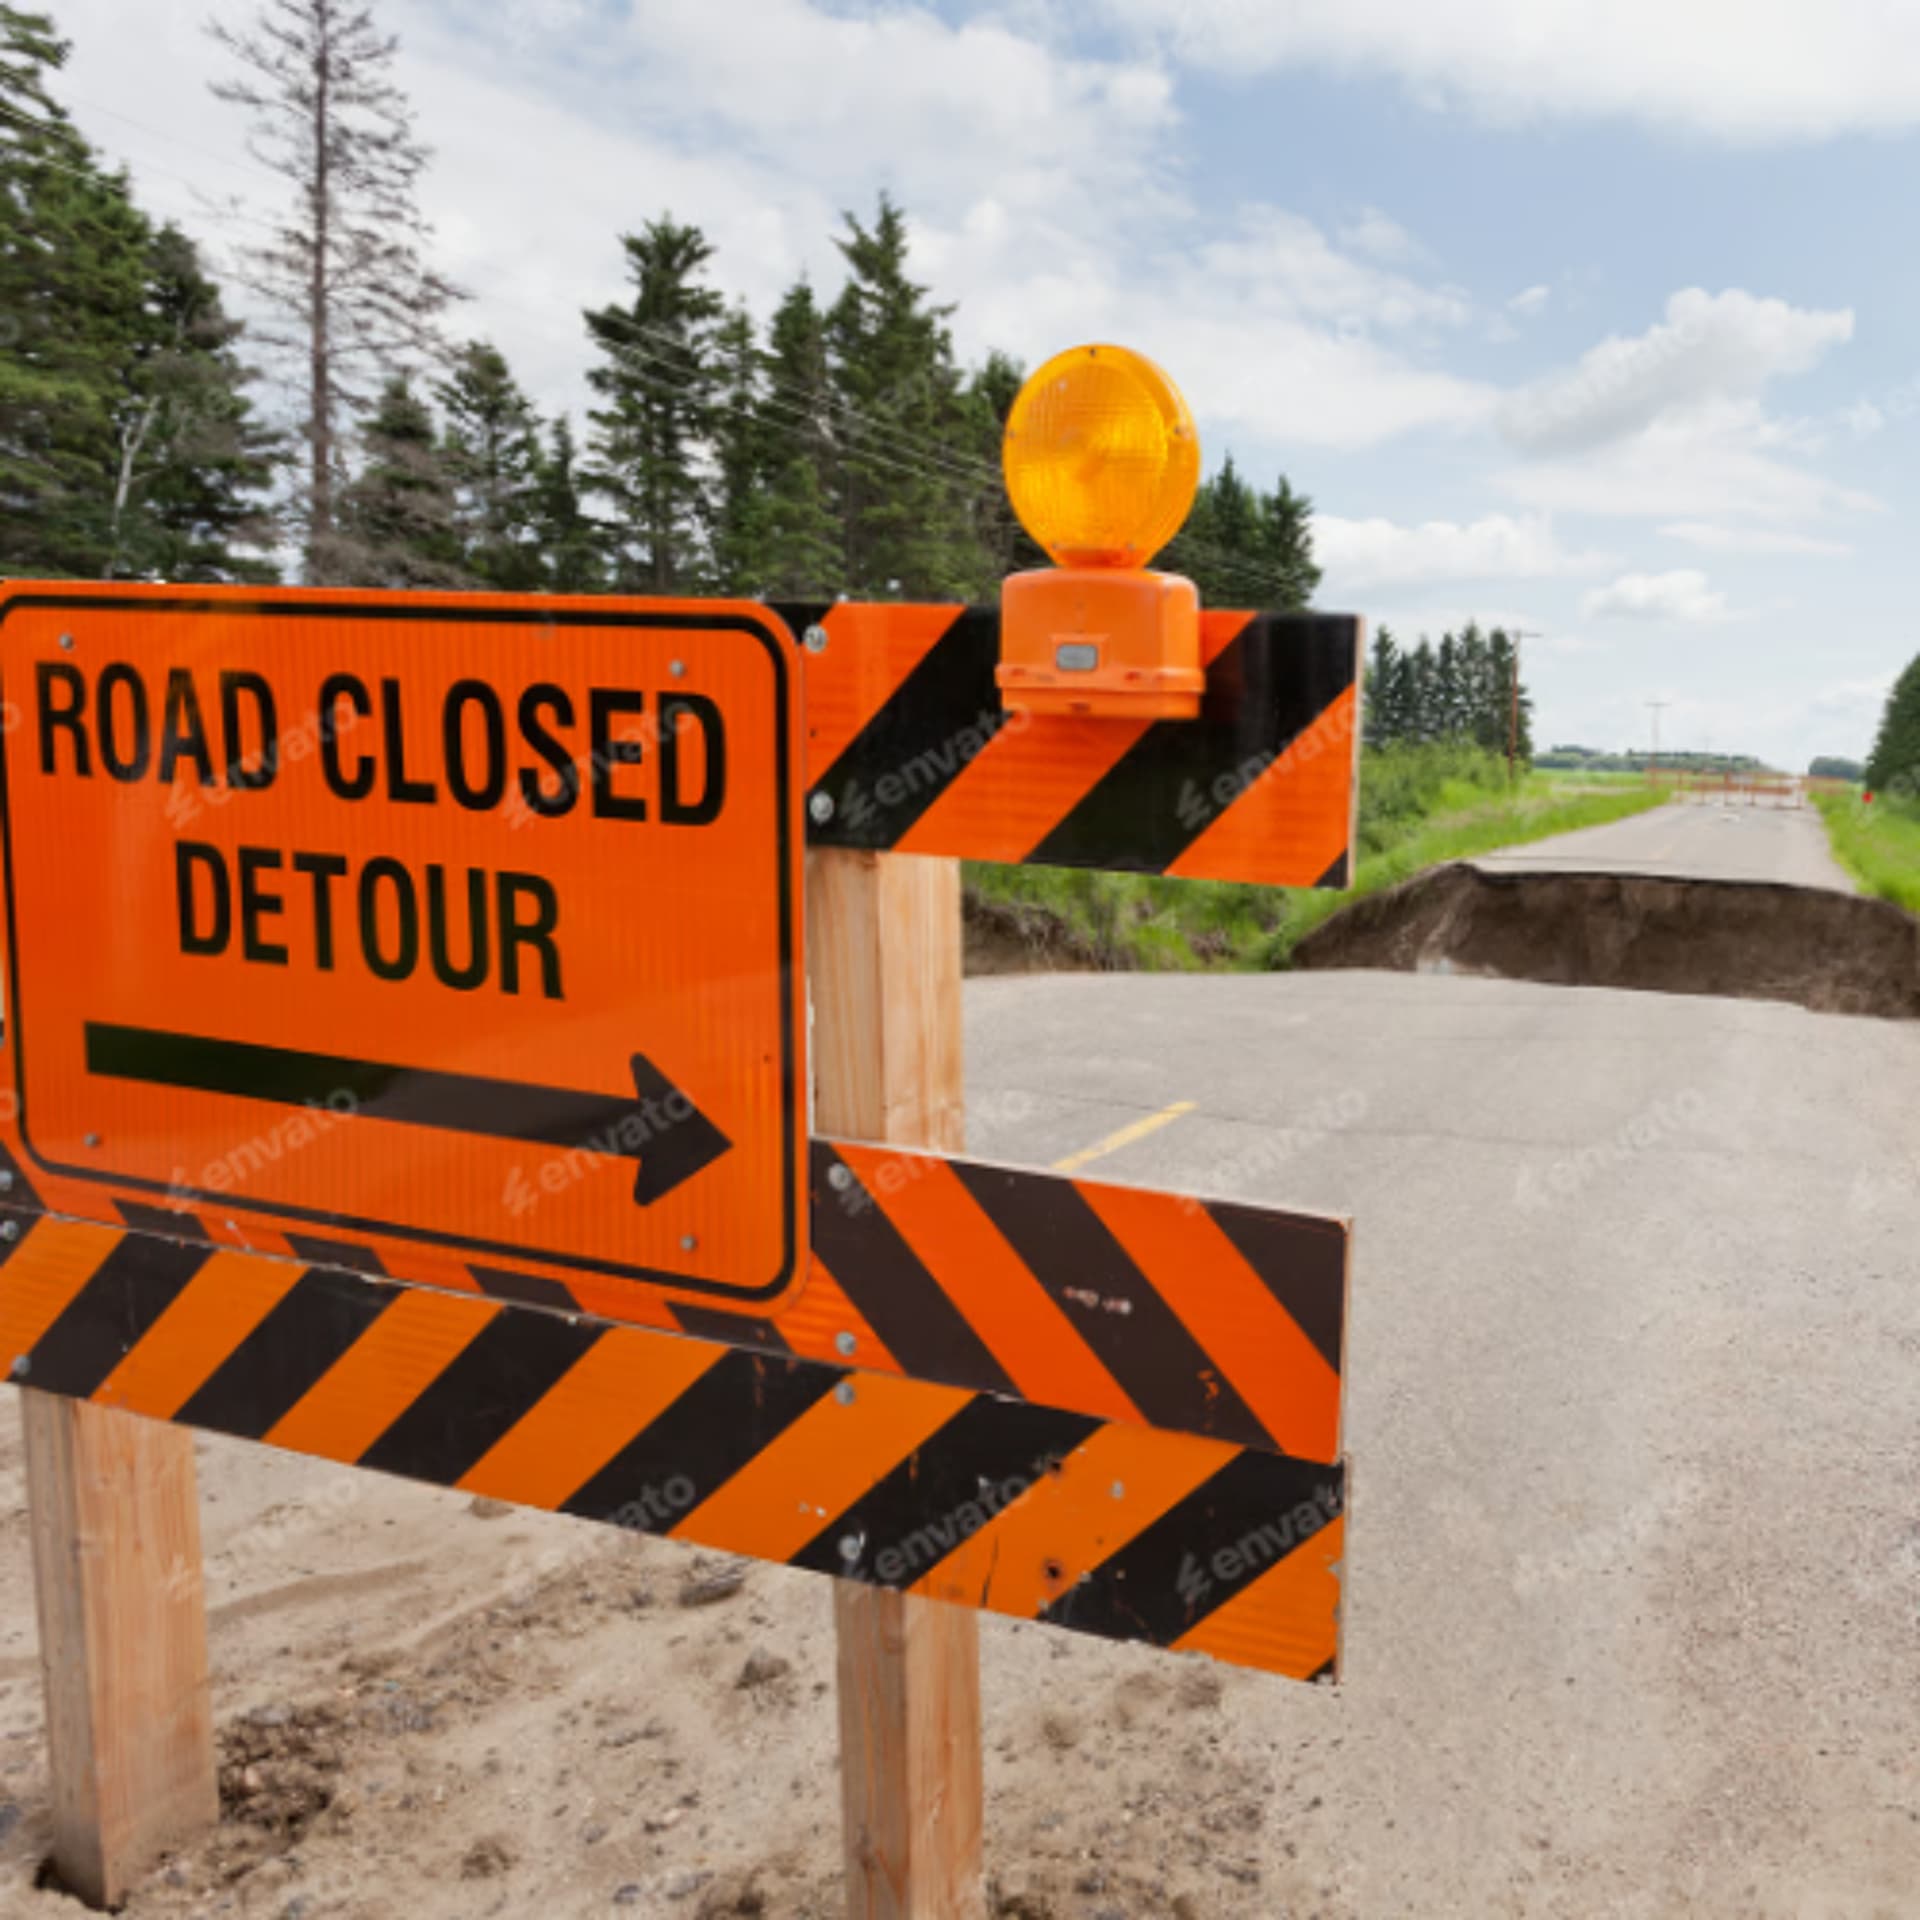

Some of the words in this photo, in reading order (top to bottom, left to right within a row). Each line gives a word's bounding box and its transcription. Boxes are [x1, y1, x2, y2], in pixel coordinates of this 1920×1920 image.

[36, 661, 278, 791] ROAD
[318, 672, 727, 827] CLOSED
[175, 840, 564, 1000] DETOUR
